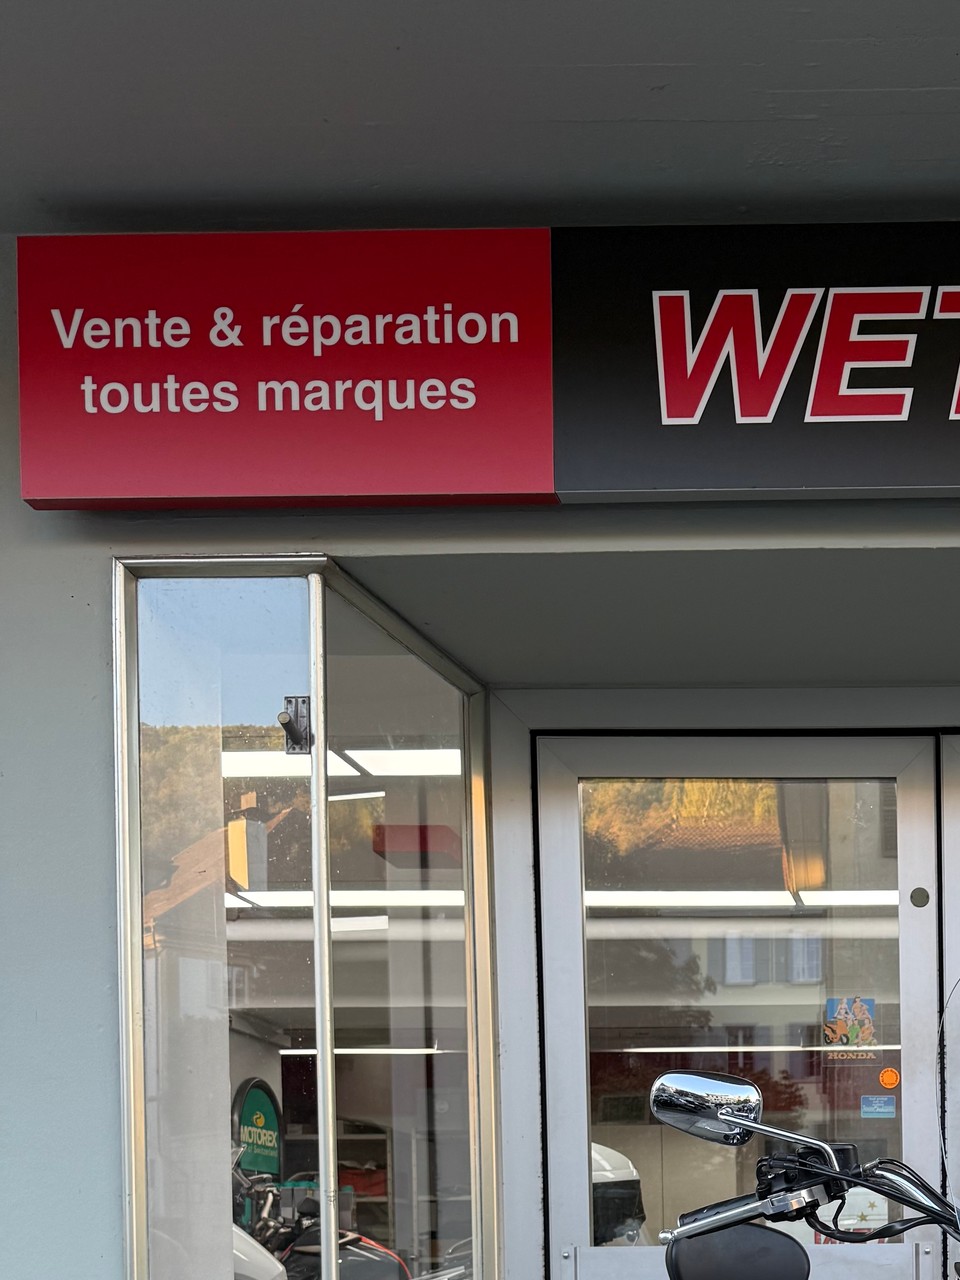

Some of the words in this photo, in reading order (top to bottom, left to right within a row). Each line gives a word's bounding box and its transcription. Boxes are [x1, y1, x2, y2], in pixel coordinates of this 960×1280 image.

[51, 308, 191, 349] Vente
[209, 306, 244, 348] &
[262, 303, 519, 357] réparation
[81, 374, 239, 414] toutes
[257, 376, 477, 421] marques
[828, 1052, 876, 1060] HONDA
[240, 1125, 278, 1148] MOTOREX
